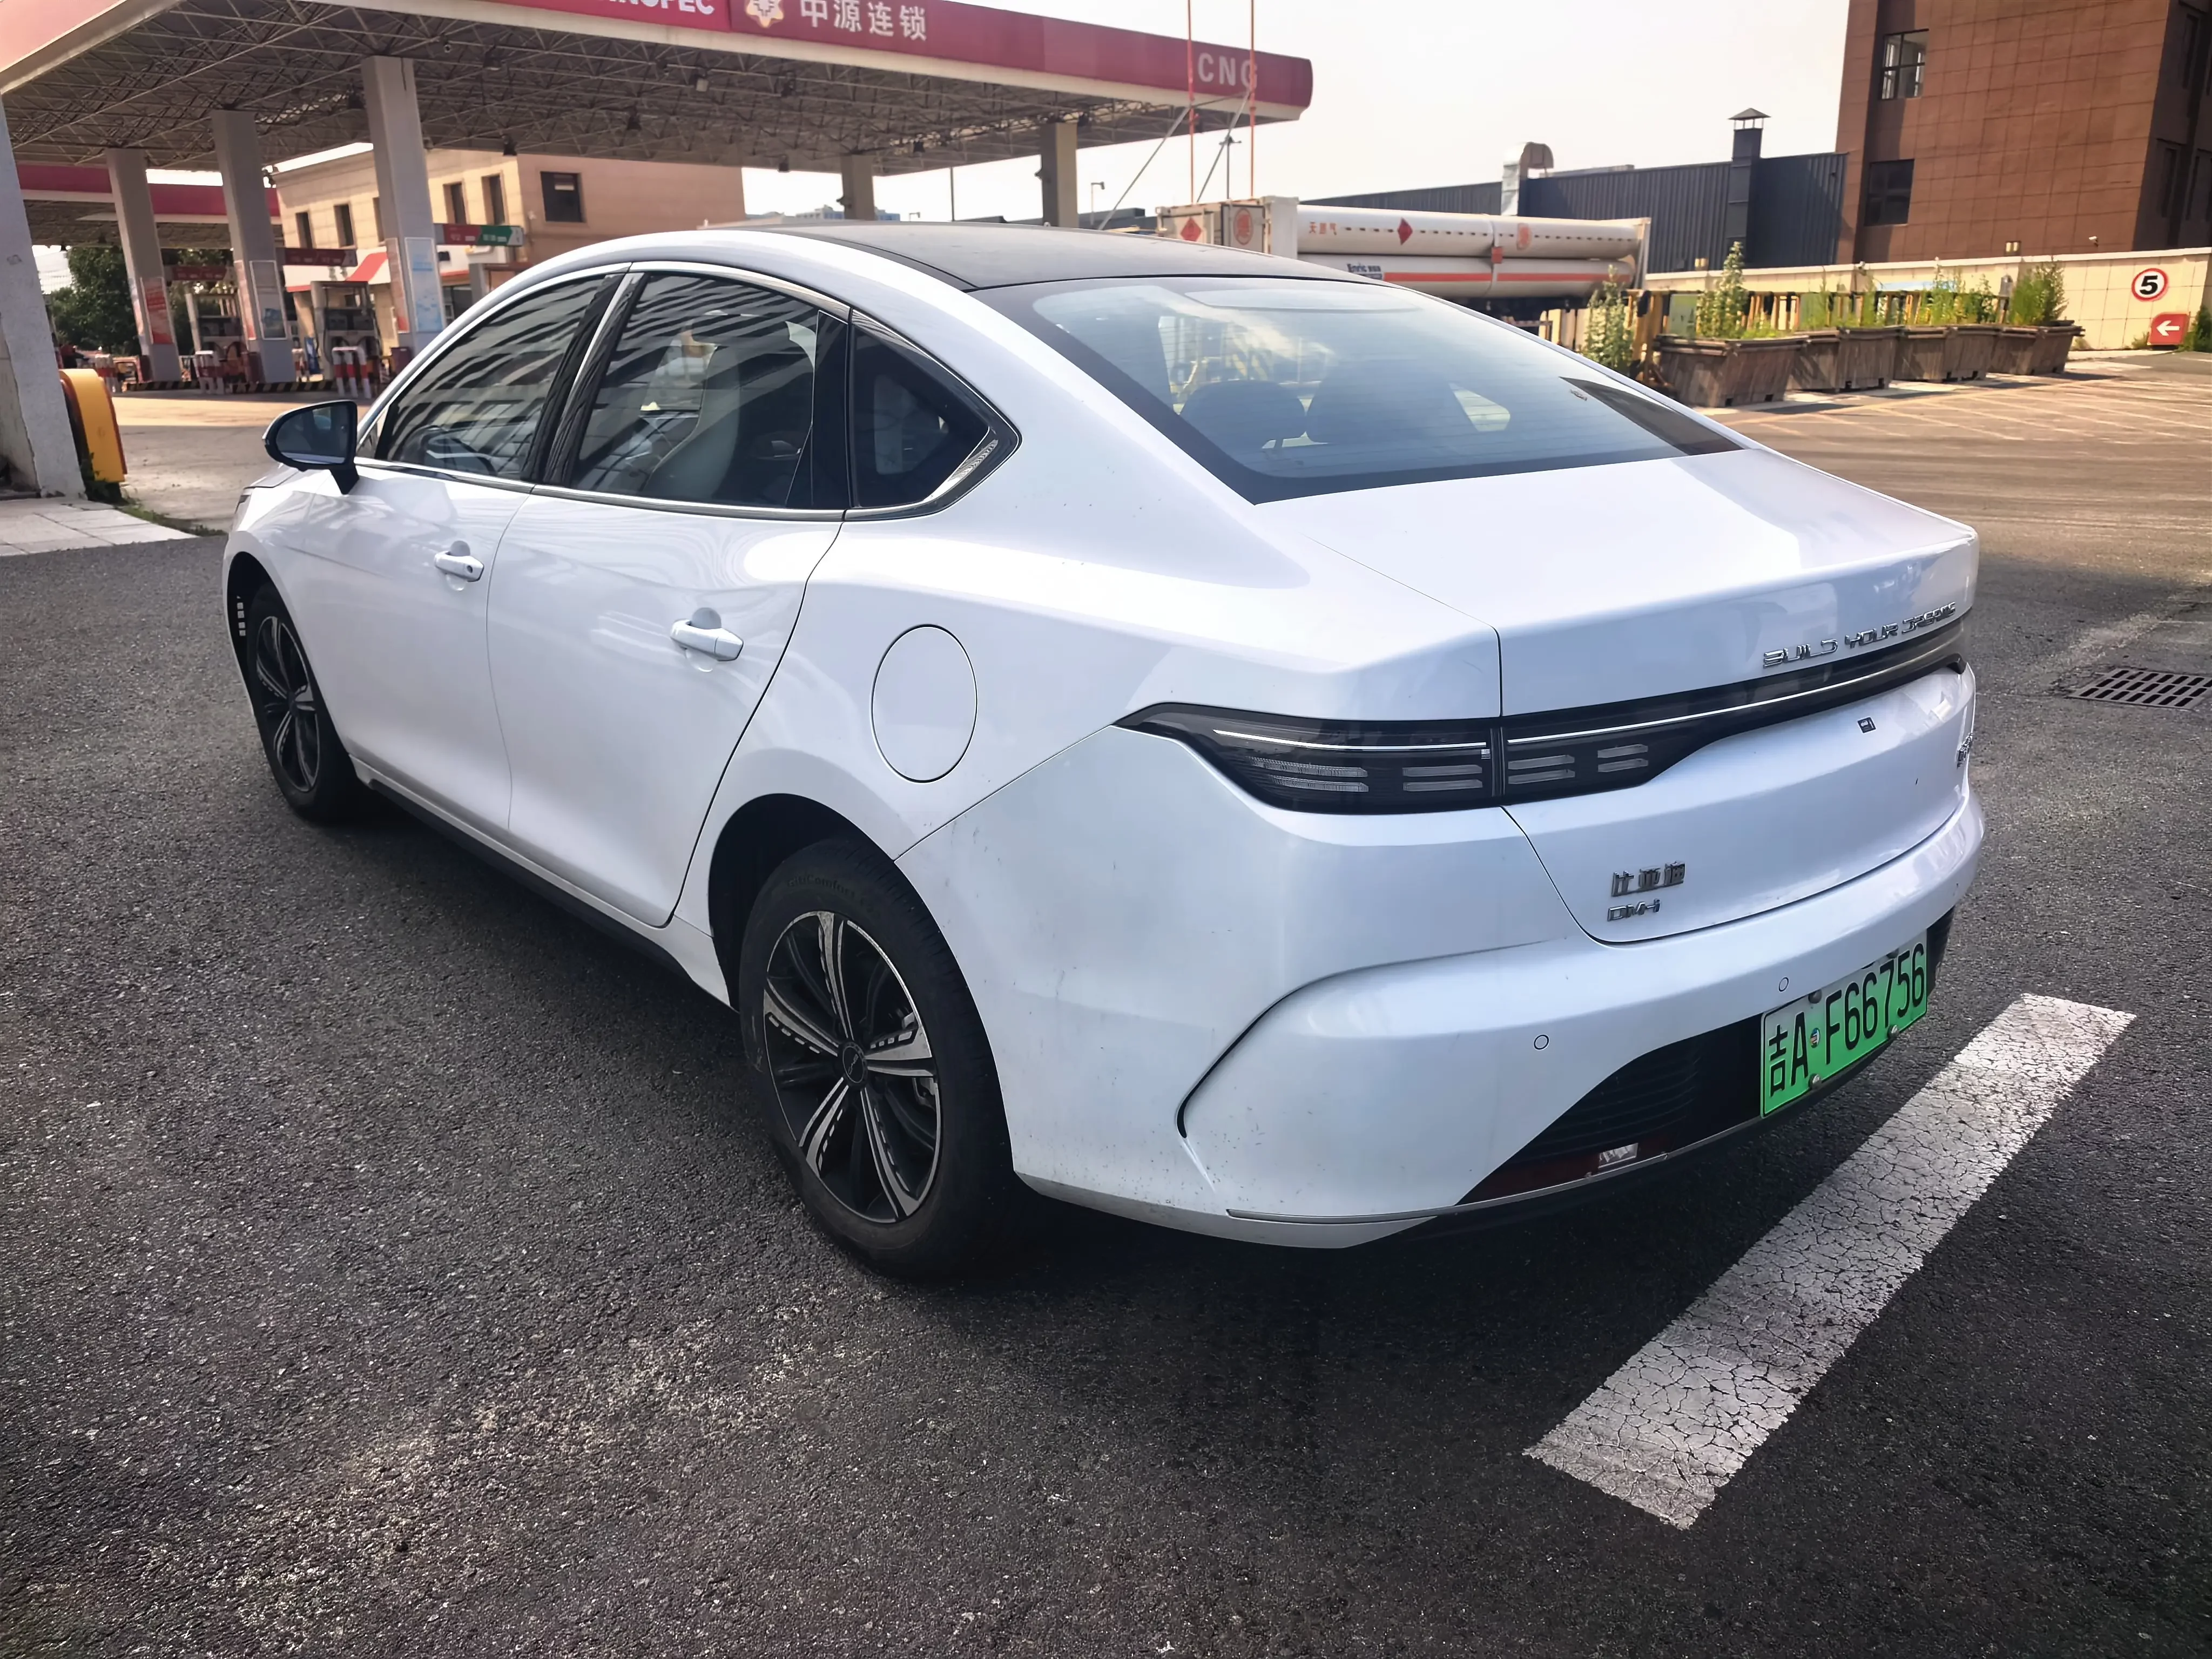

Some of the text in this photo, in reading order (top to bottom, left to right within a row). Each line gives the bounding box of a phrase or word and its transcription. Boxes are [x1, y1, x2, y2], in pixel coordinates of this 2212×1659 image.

[800, 0, 927, 41] 中源连锁
[1198, 52, 1258, 90] CNG
[2140, 275, 2158, 295] 5
[1763, 638, 1838, 669] BUILD
[1844, 622, 1899, 649] YOUR
[1607, 898, 1661, 922] DM-i
